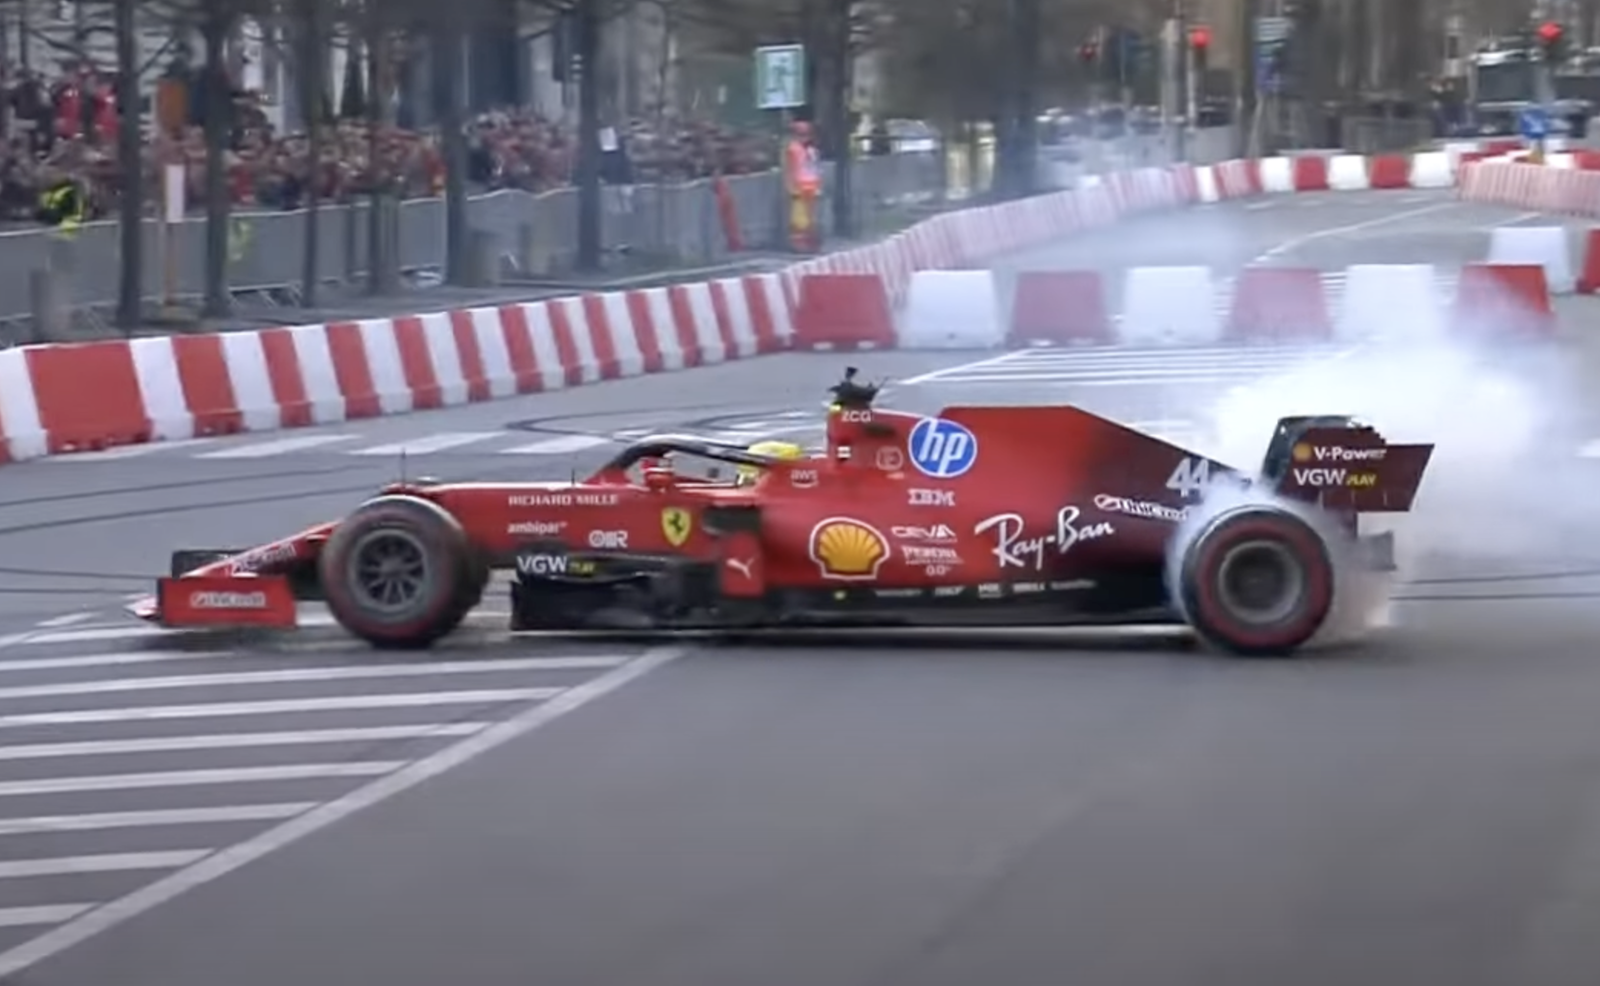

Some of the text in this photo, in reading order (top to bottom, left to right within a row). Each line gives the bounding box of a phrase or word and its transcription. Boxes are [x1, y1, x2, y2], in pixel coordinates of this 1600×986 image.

[917, 417, 969, 475] hp
[1165, 457, 1210, 498] 44
[1293, 468, 1346, 486] VGW
[508, 495, 618, 506] RICHARD MILLE
[907, 489, 955, 506] IBM
[974, 506, 1114, 571] Ray-Ban
[517, 556, 568, 573] VGW
